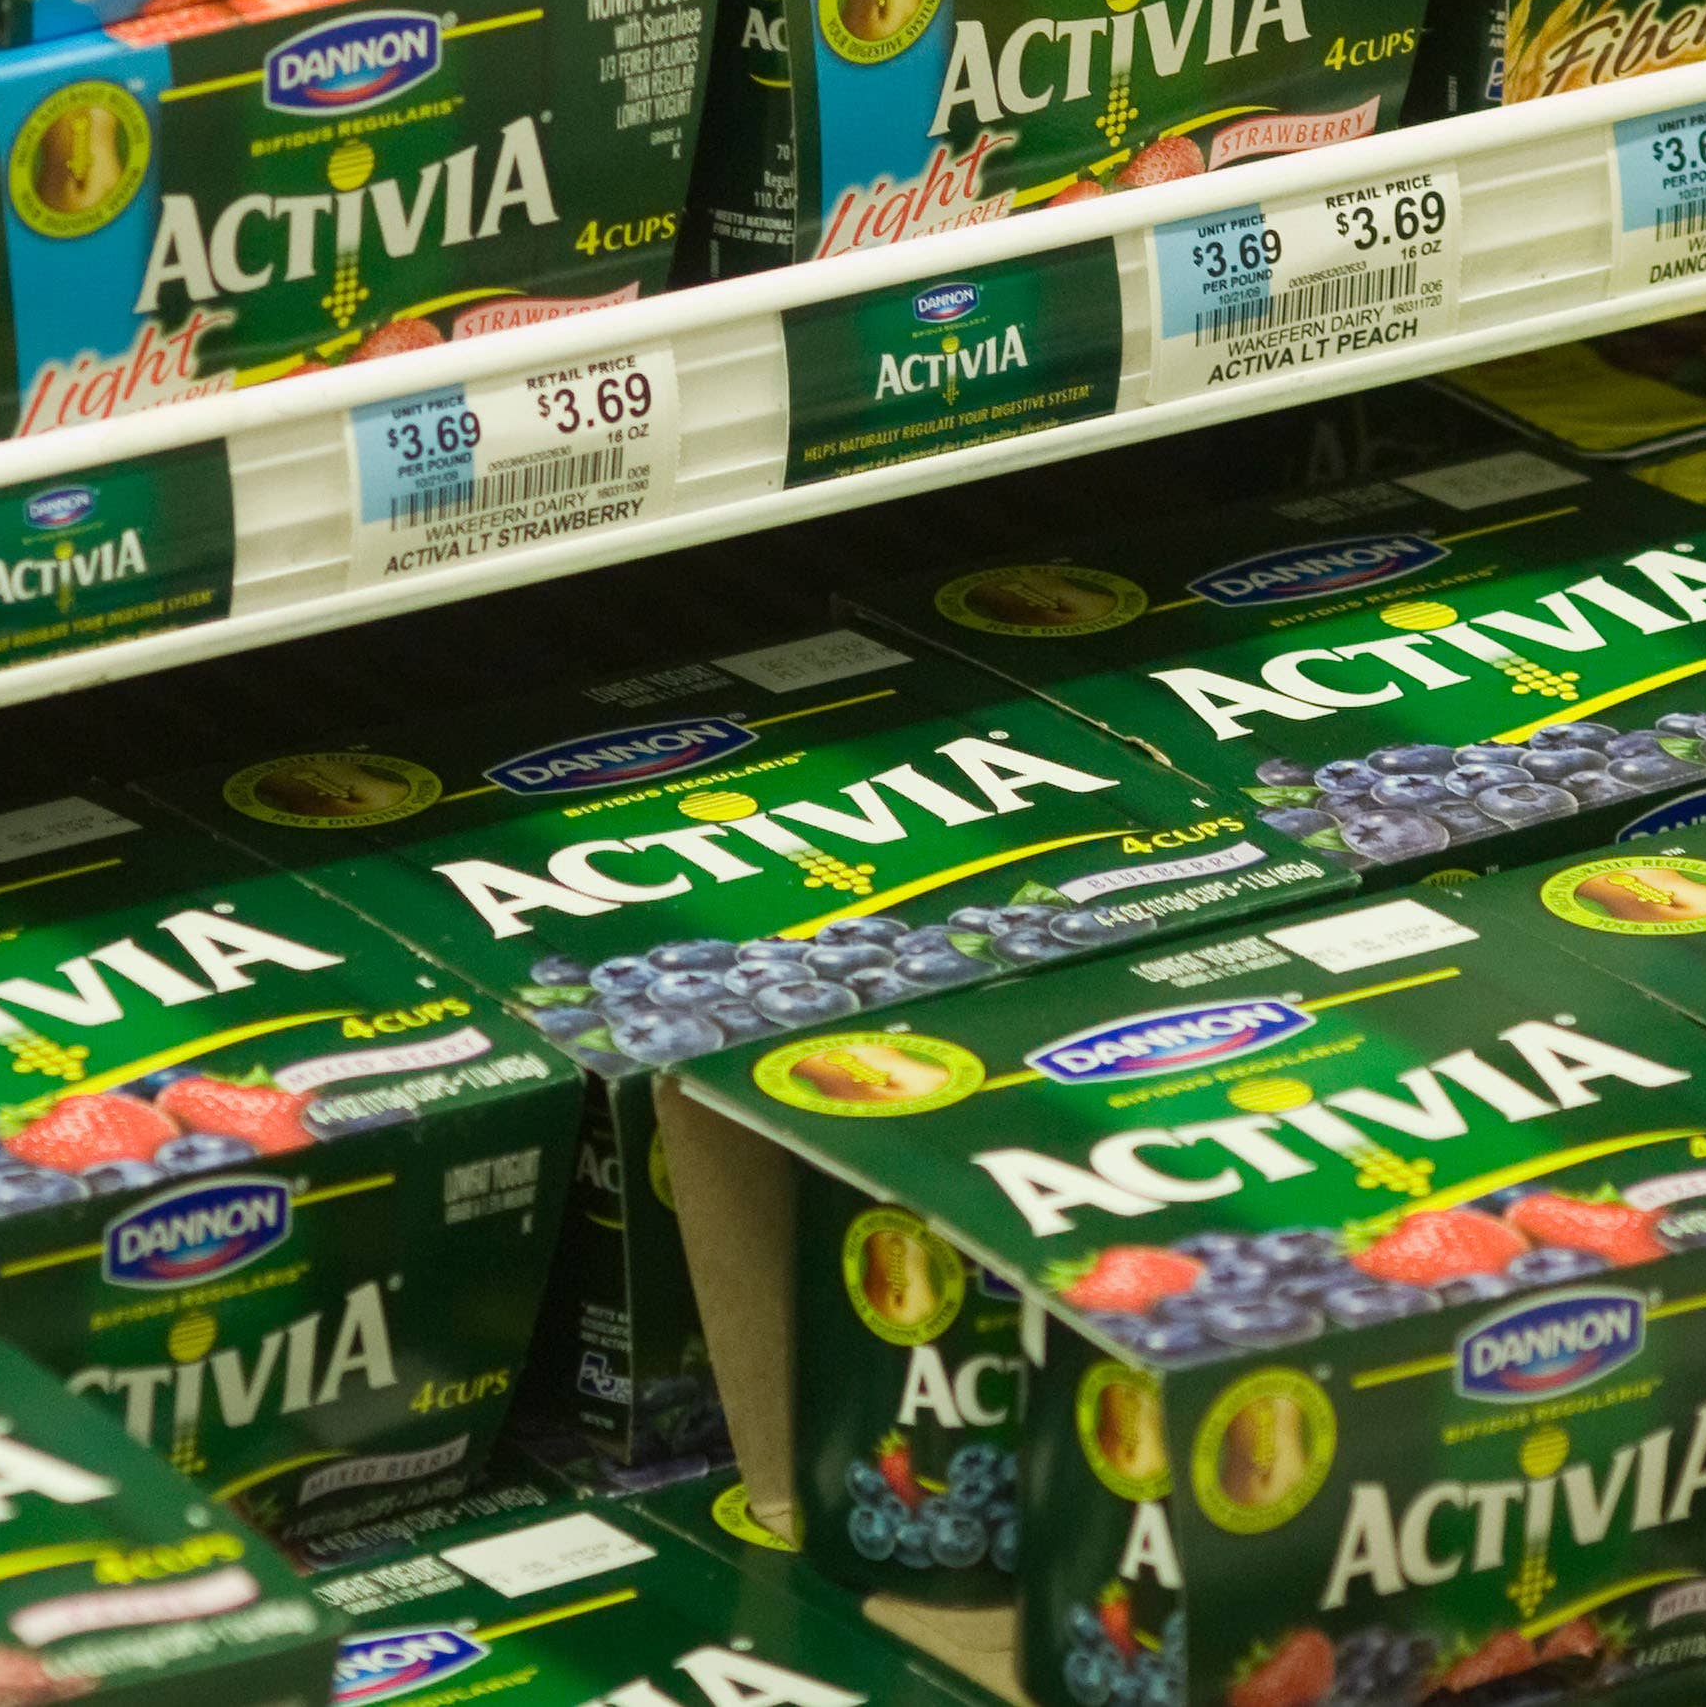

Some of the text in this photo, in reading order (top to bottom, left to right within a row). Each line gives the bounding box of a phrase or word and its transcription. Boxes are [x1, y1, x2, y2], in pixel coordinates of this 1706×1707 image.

[1193, 229, 1282, 278] $3.69
[1336, 190, 1445, 250] $3.69
[874, 325, 1030, 400] ACTIVIA
[1207, 317, 1419, 385] ACTIVA LT PEACH
[1228, 306, 1385, 358] WAKEFERN DAIRY
[538, 371, 652, 435] $3.69
[958, 410, 989, 430] YOUR
[991, 396, 1046, 421] DIGESTIVE
[384, 496, 645, 576] ACTIVA LT STRAWBERRY
[508, 722, 731, 788] DANNON
[433, 735, 1120, 940] ACTIVIA
[970, 1016, 1694, 1240] ACTIVIA
[1468, 1312, 1636, 1381] DANNON
